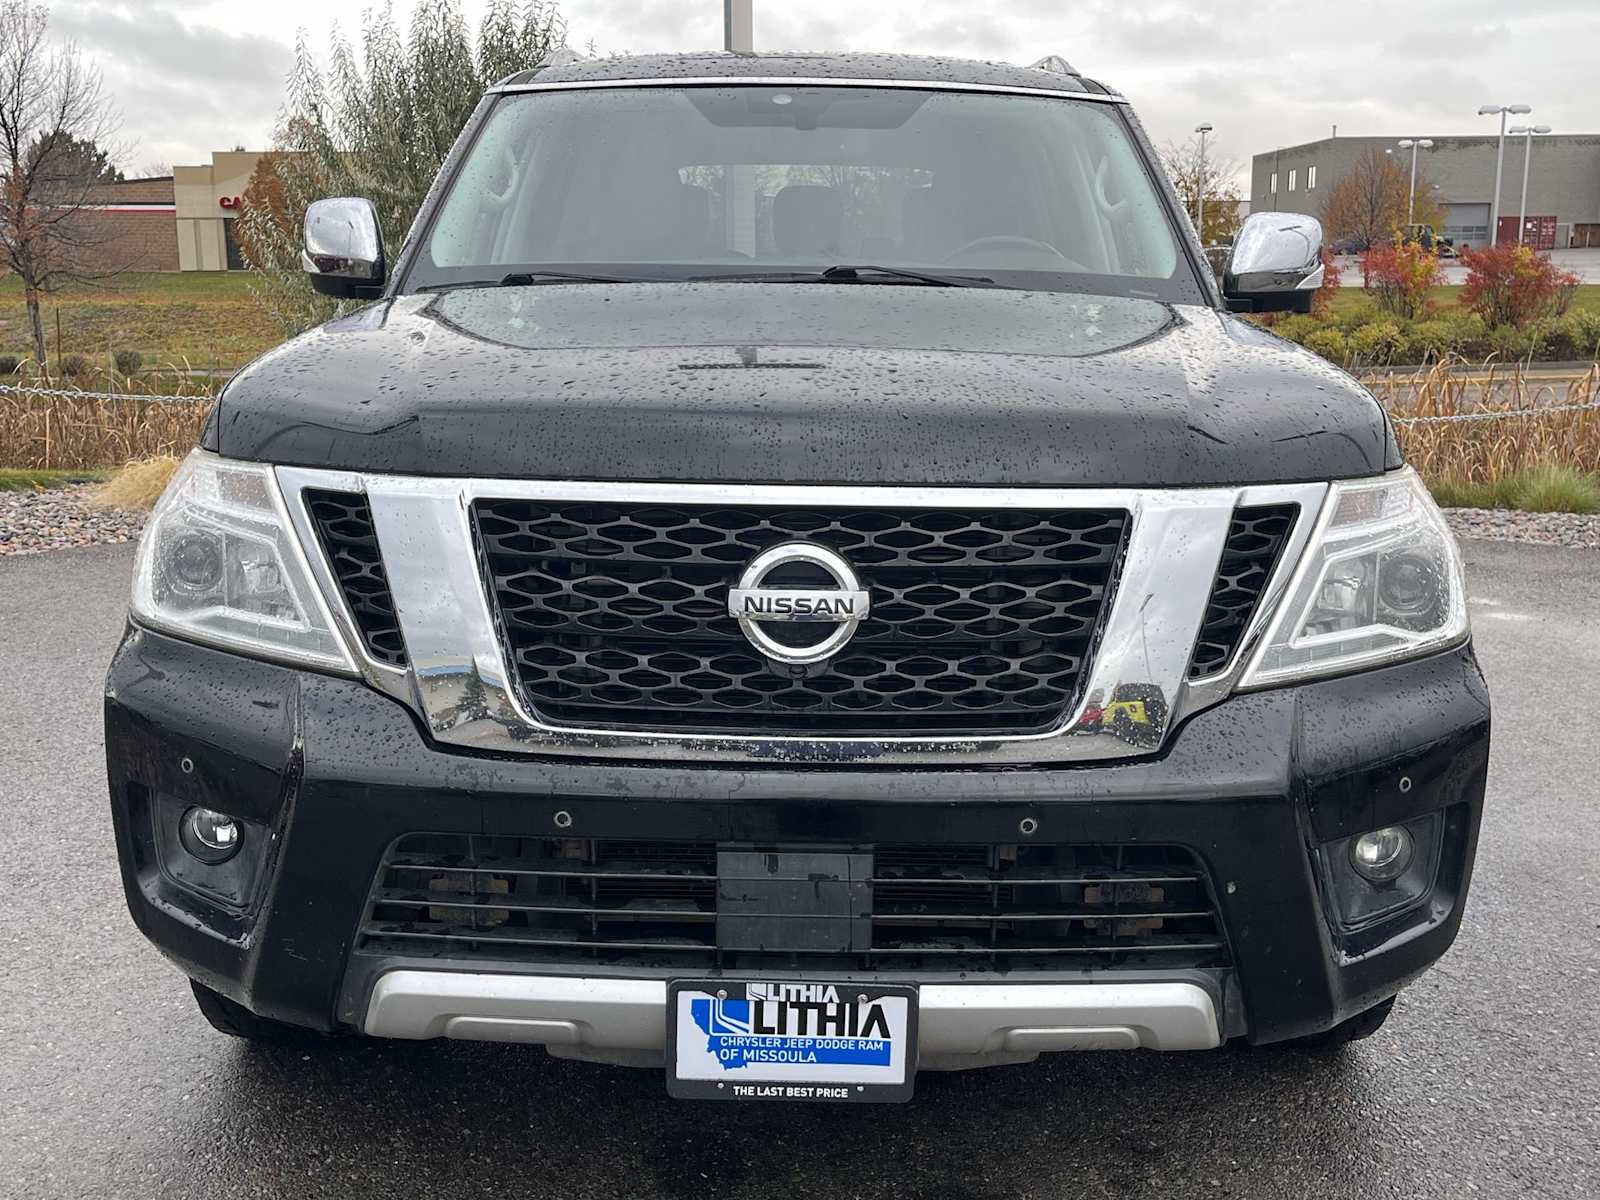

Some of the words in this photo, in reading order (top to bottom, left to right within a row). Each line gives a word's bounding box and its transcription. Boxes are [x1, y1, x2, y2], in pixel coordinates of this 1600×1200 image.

[744, 596, 854, 615] NISSAN
[767, 983, 840, 1003] LITHIA
[753, 1001, 891, 1038] LITHIA
[720, 1037, 781, 1049] CHRYSLER
[783, 1038, 813, 1049] JEEP
[815, 1039, 855, 1050] DODGE
[858, 1041, 884, 1051] RAM
[720, 1049, 738, 1061] OF
[743, 1050, 817, 1063] MISSOULA
[733, 1086, 755, 1096] THE
[757, 1087, 785, 1097] LAST
[786, 1087, 815, 1098] BEST
[816, 1088, 849, 1099] PRICE
